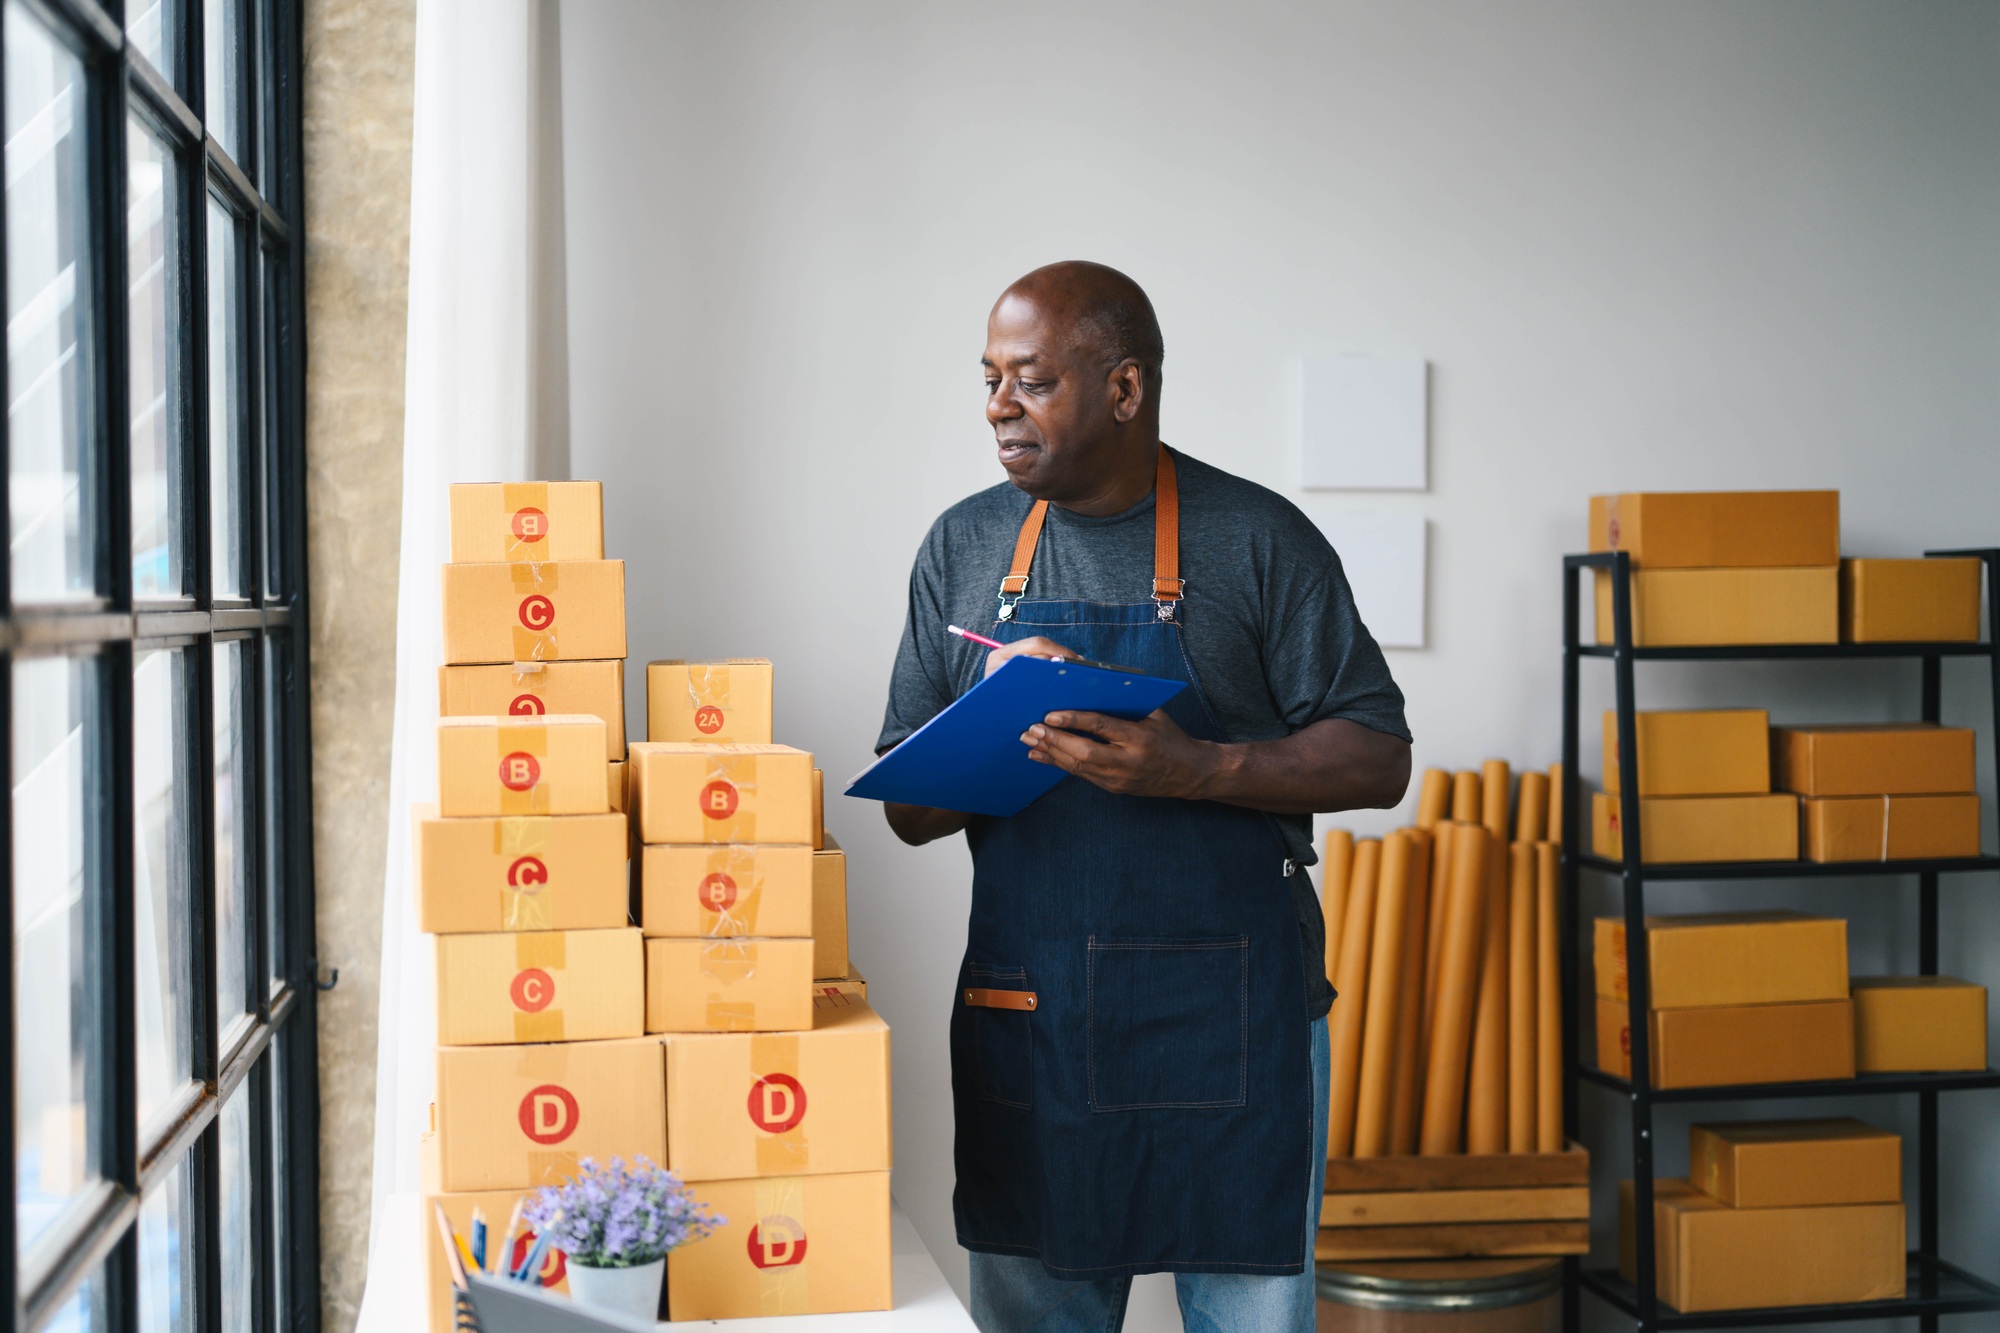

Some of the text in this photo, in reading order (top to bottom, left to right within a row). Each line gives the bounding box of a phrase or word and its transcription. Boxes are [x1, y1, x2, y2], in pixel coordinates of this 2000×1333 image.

[521, 516, 539, 536] B
[526, 600, 548, 626] C
[698, 713, 720, 727] 2A
[510, 759, 531, 783] B
[711, 790, 729, 811] B
[515, 862, 540, 890] C
[710, 881, 727, 903] B
[523, 978, 542, 1003] C
[533, 1095, 568, 1136] D
[763, 1083, 795, 1124] D
[762, 1225, 796, 1265] D
